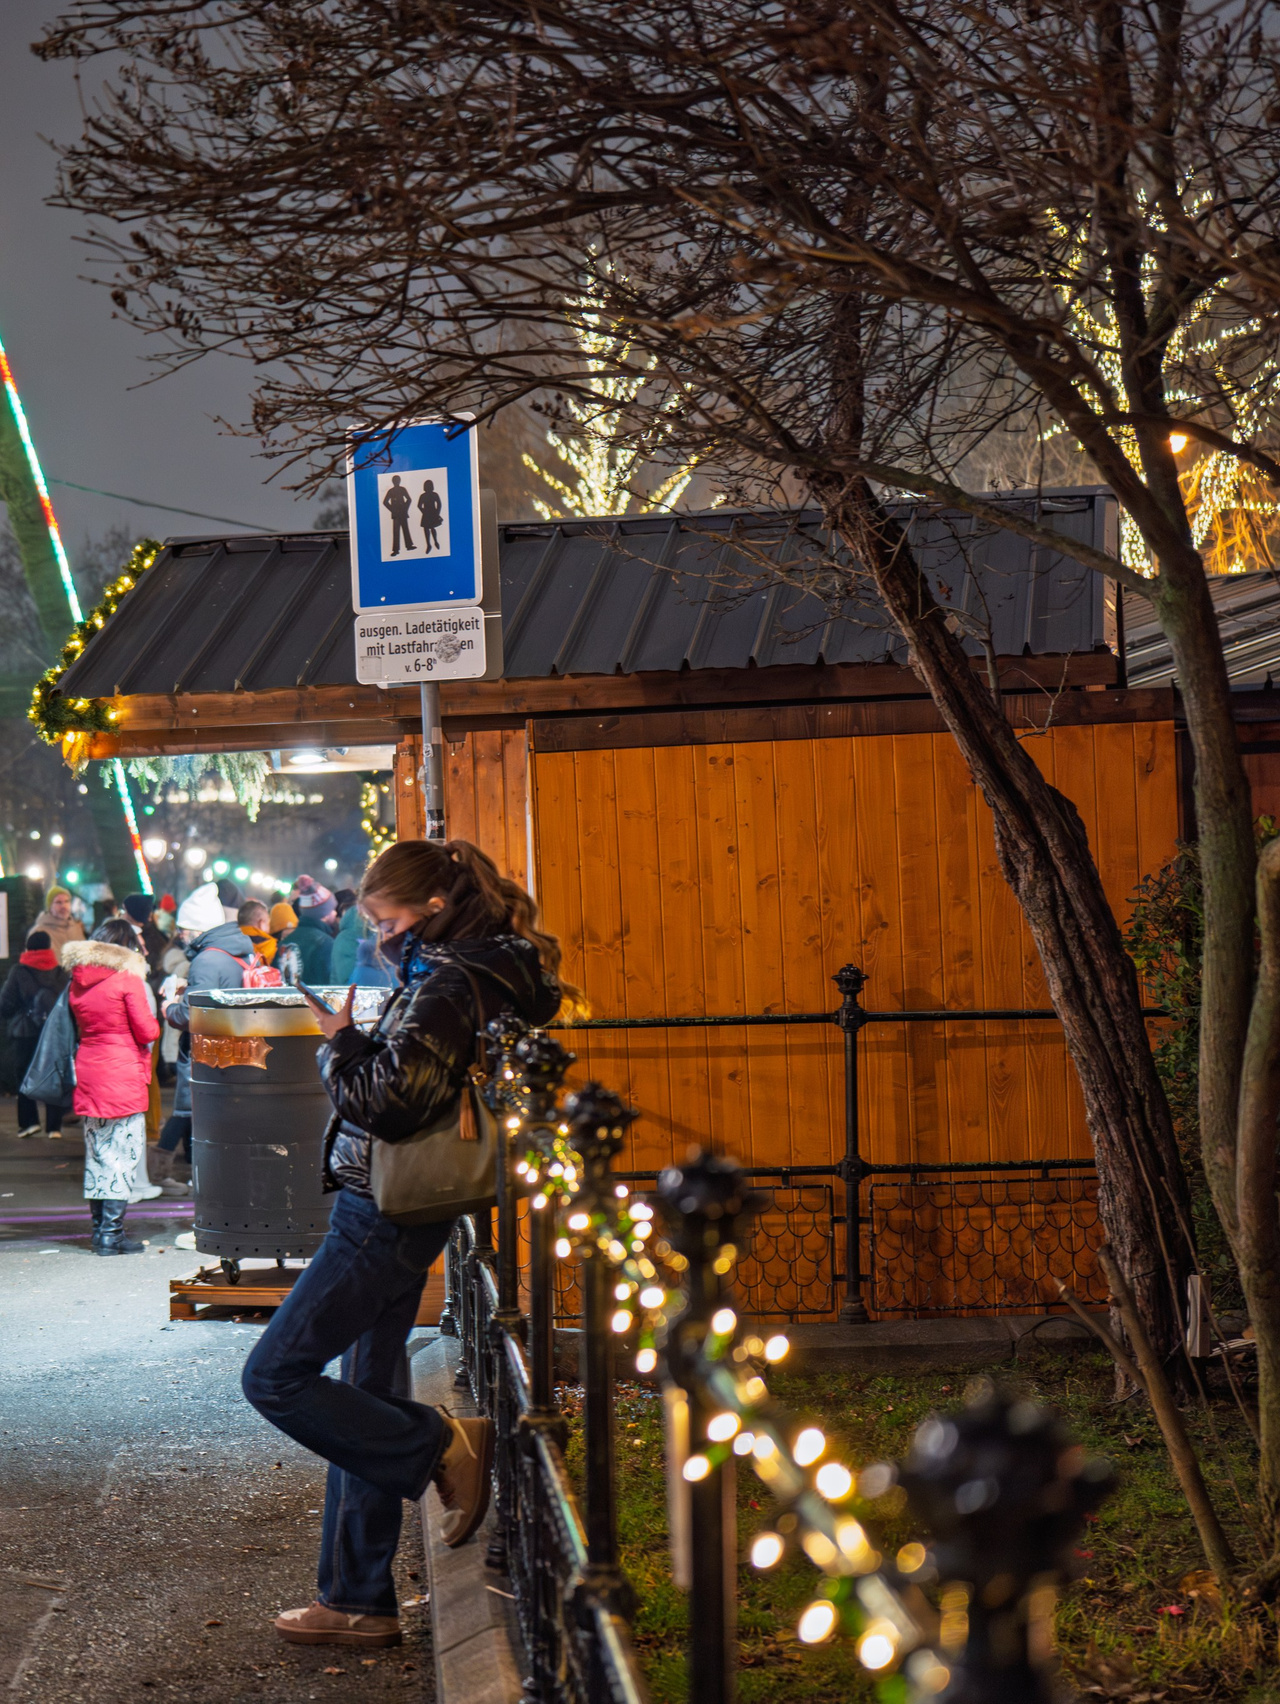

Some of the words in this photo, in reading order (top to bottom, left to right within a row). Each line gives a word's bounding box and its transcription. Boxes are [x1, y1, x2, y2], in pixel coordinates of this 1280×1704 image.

[359, 625, 402, 640] ausgen.
[405, 617, 480, 634] Ladetätigkeit
[366, 642, 386, 656] mit
[388, 639, 474, 655] Lastfahren
[404, 664, 412, 672] v.
